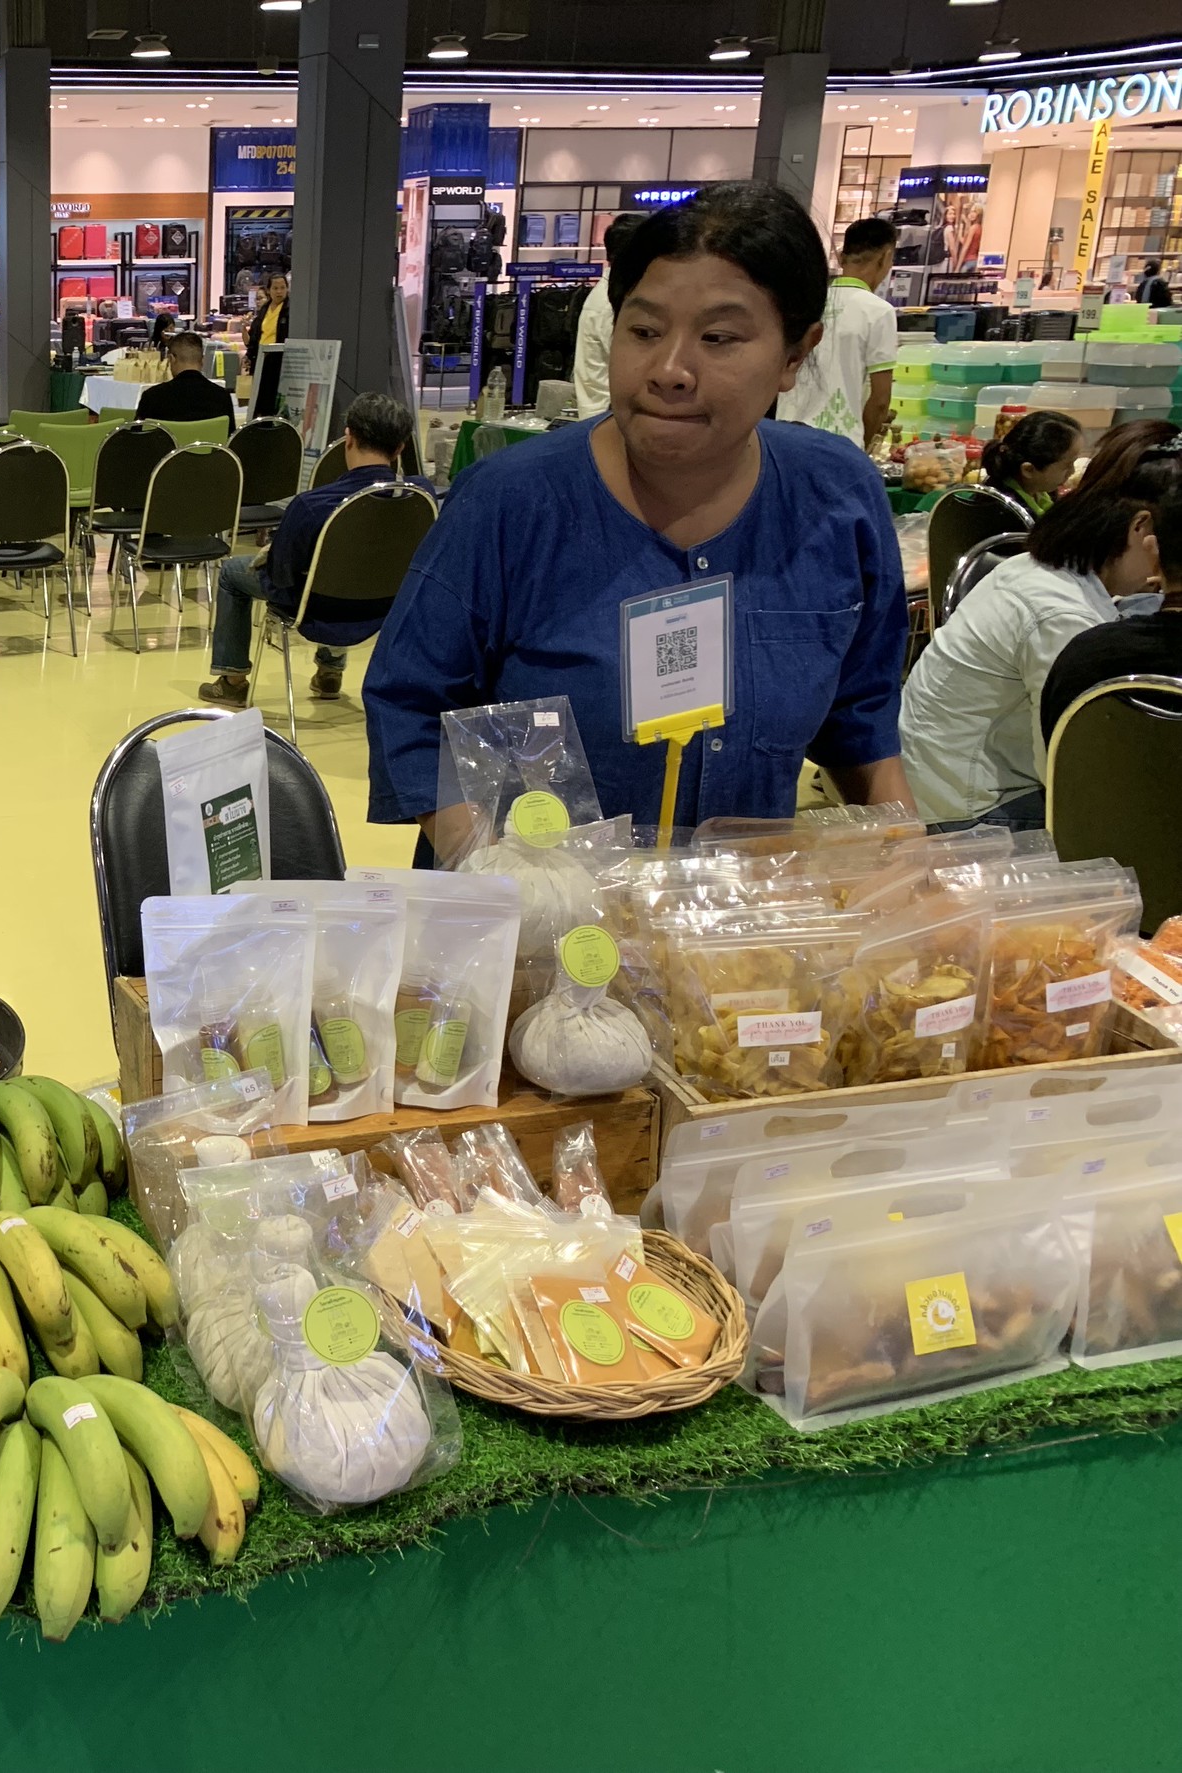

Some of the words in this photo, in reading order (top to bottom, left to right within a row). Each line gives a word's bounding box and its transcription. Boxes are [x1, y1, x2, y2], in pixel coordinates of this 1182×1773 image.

[981, 69, 1182, 133] ROBINSON
[1091, 123, 1108, 174] ALE
[756, 1021, 786, 1029] THANK
[789, 1019, 807, 1027] YOU
[245, 1084, 256, 1094] 65
[333, 1183, 347, 1194] 65
